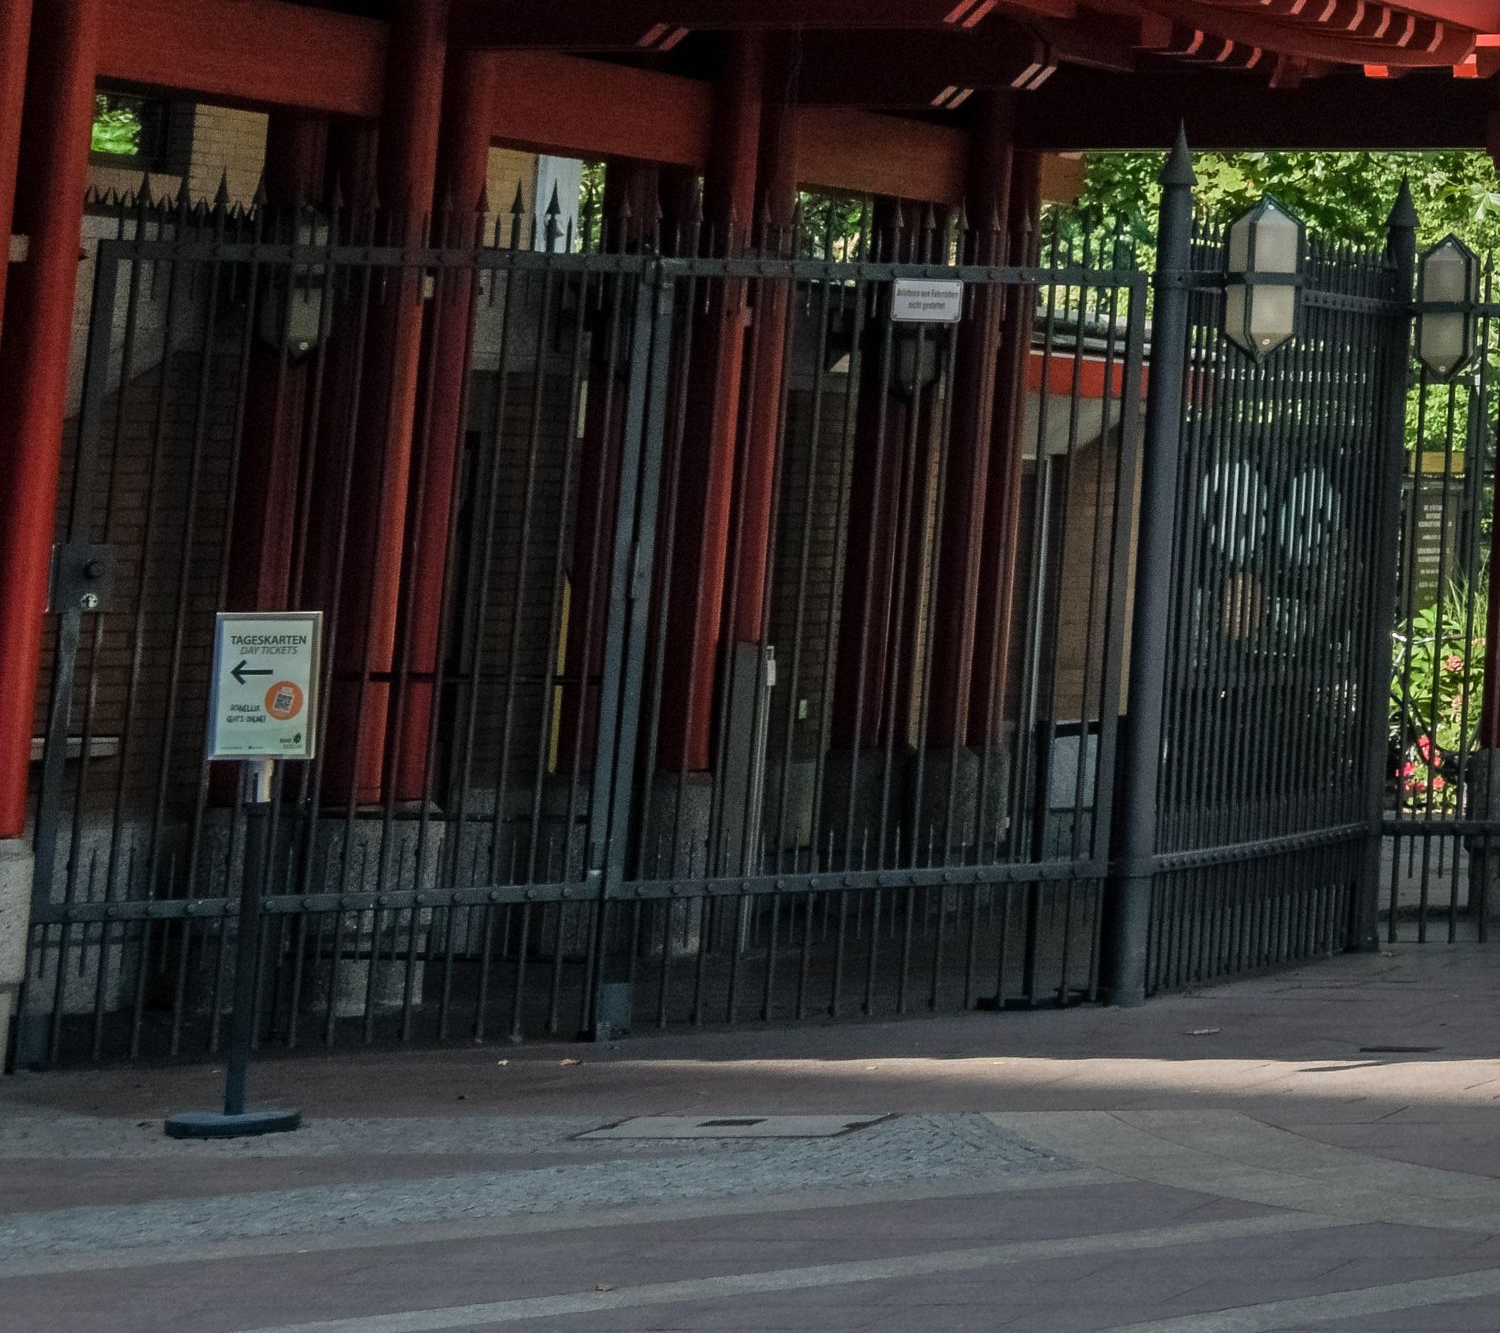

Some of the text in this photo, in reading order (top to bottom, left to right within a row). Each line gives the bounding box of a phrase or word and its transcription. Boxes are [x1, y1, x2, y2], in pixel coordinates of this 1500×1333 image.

[230, 635, 307, 645] TAGESKARTEN
[239, 645, 298, 655] DAY TICKETS
